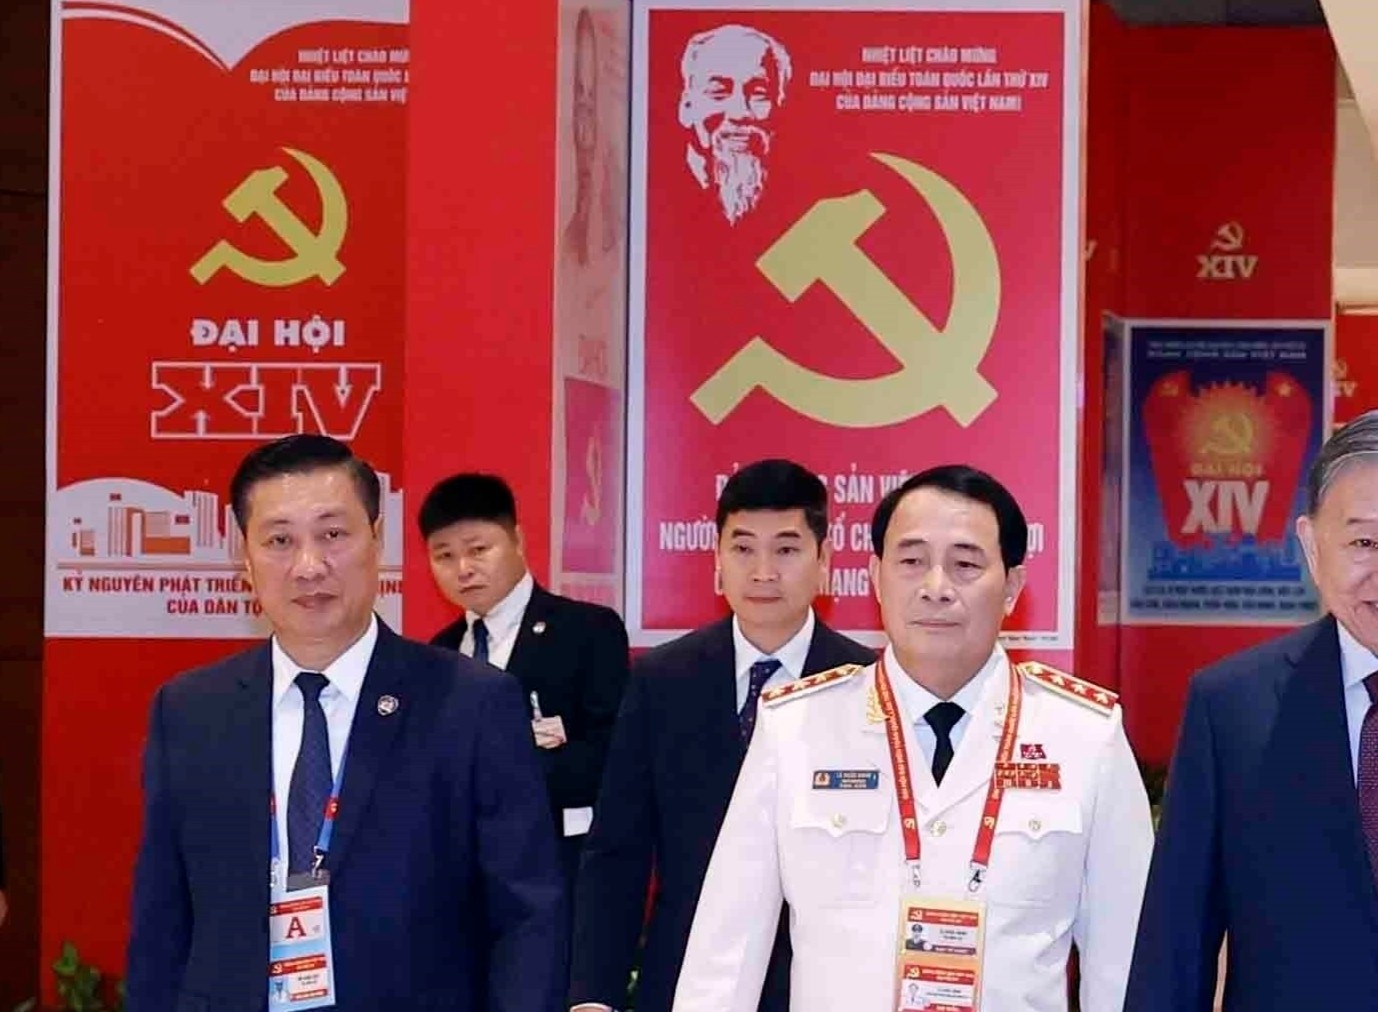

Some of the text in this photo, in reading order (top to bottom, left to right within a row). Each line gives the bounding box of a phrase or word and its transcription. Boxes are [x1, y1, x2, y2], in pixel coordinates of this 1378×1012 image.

[1197, 255, 1258, 279] XIV
[191, 315, 345, 353] ĐẠI HỘI
[151, 361, 381, 440] XIV
[834, 463, 874, 503] SẢN
[1179, 480, 1270, 534] XIV
[63, 569, 83, 592] KỶ
[89, 573, 154, 592] NGUYÊN
[160, 574, 201, 593] PHÁT
[831, 568, 870, 602] ẠNG
[166, 595, 262, 618] CỦA DÂN TỘ
[286, 917, 306, 939] A
